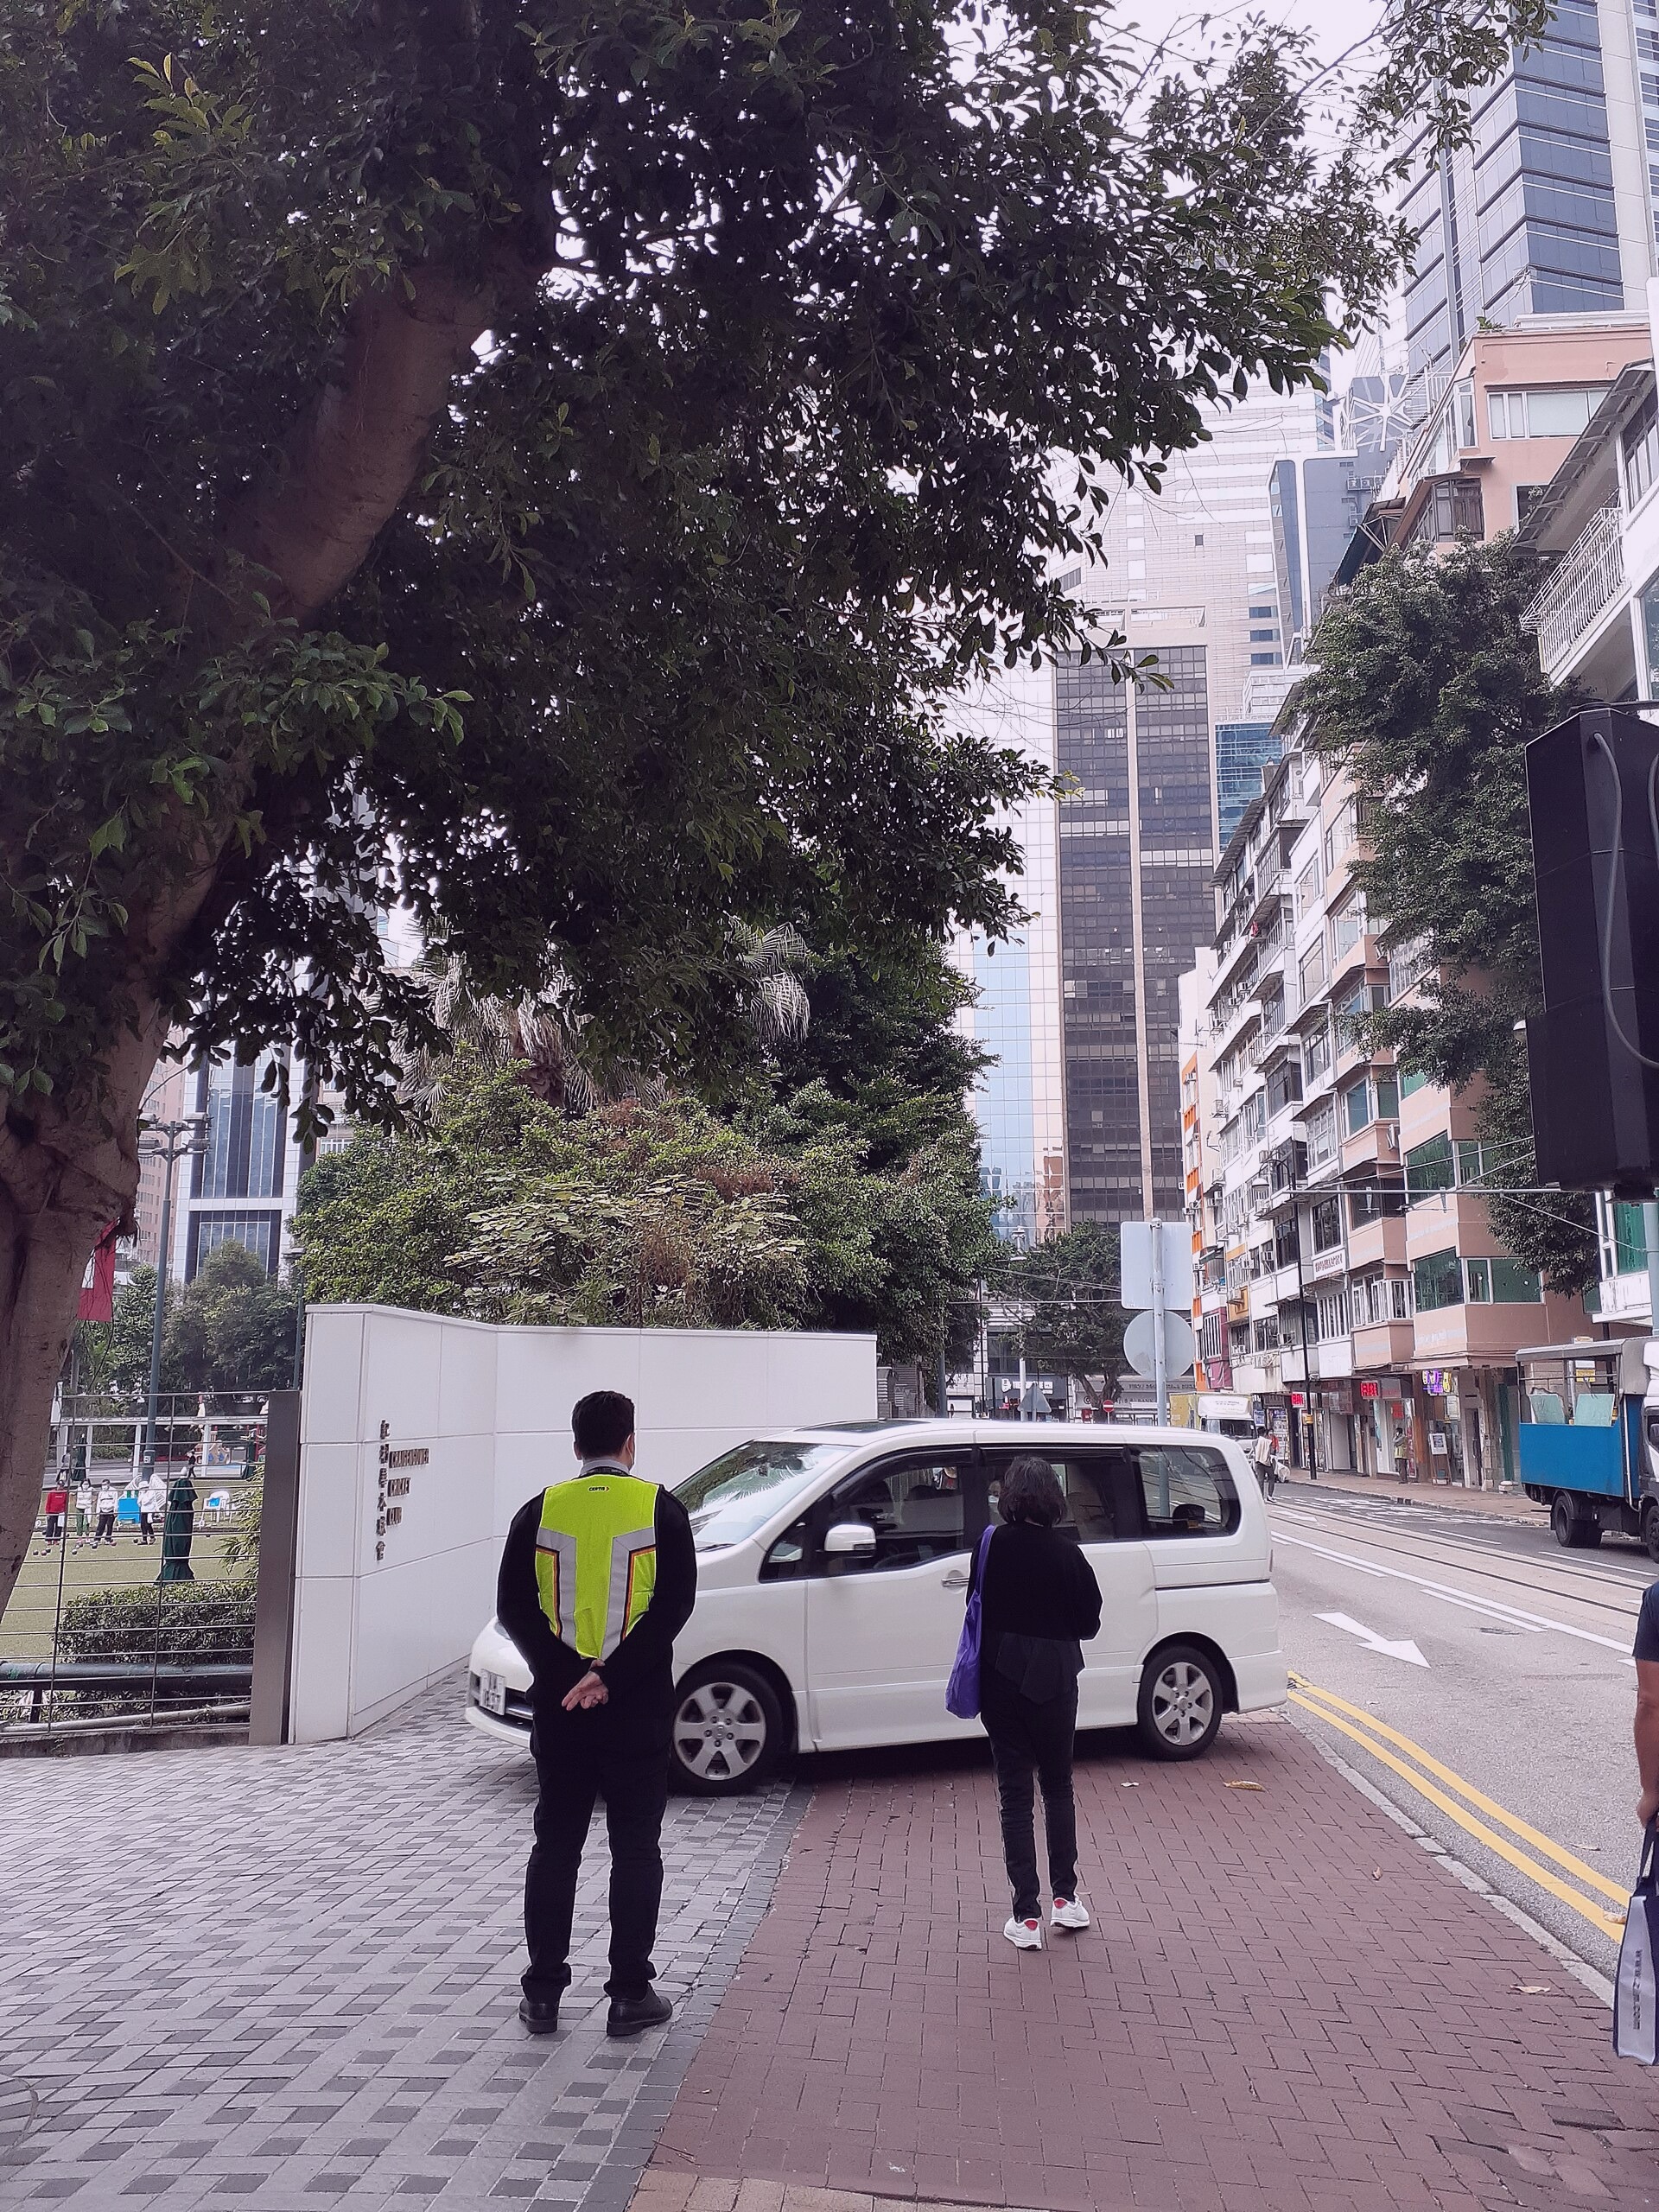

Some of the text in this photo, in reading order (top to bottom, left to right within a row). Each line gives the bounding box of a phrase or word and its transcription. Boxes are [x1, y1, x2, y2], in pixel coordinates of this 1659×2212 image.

[389, 1448, 429, 1469] CRAIGENGOWER
[387, 1477, 411, 1497] CRICKET
[386, 1506, 403, 1526] CLUB
